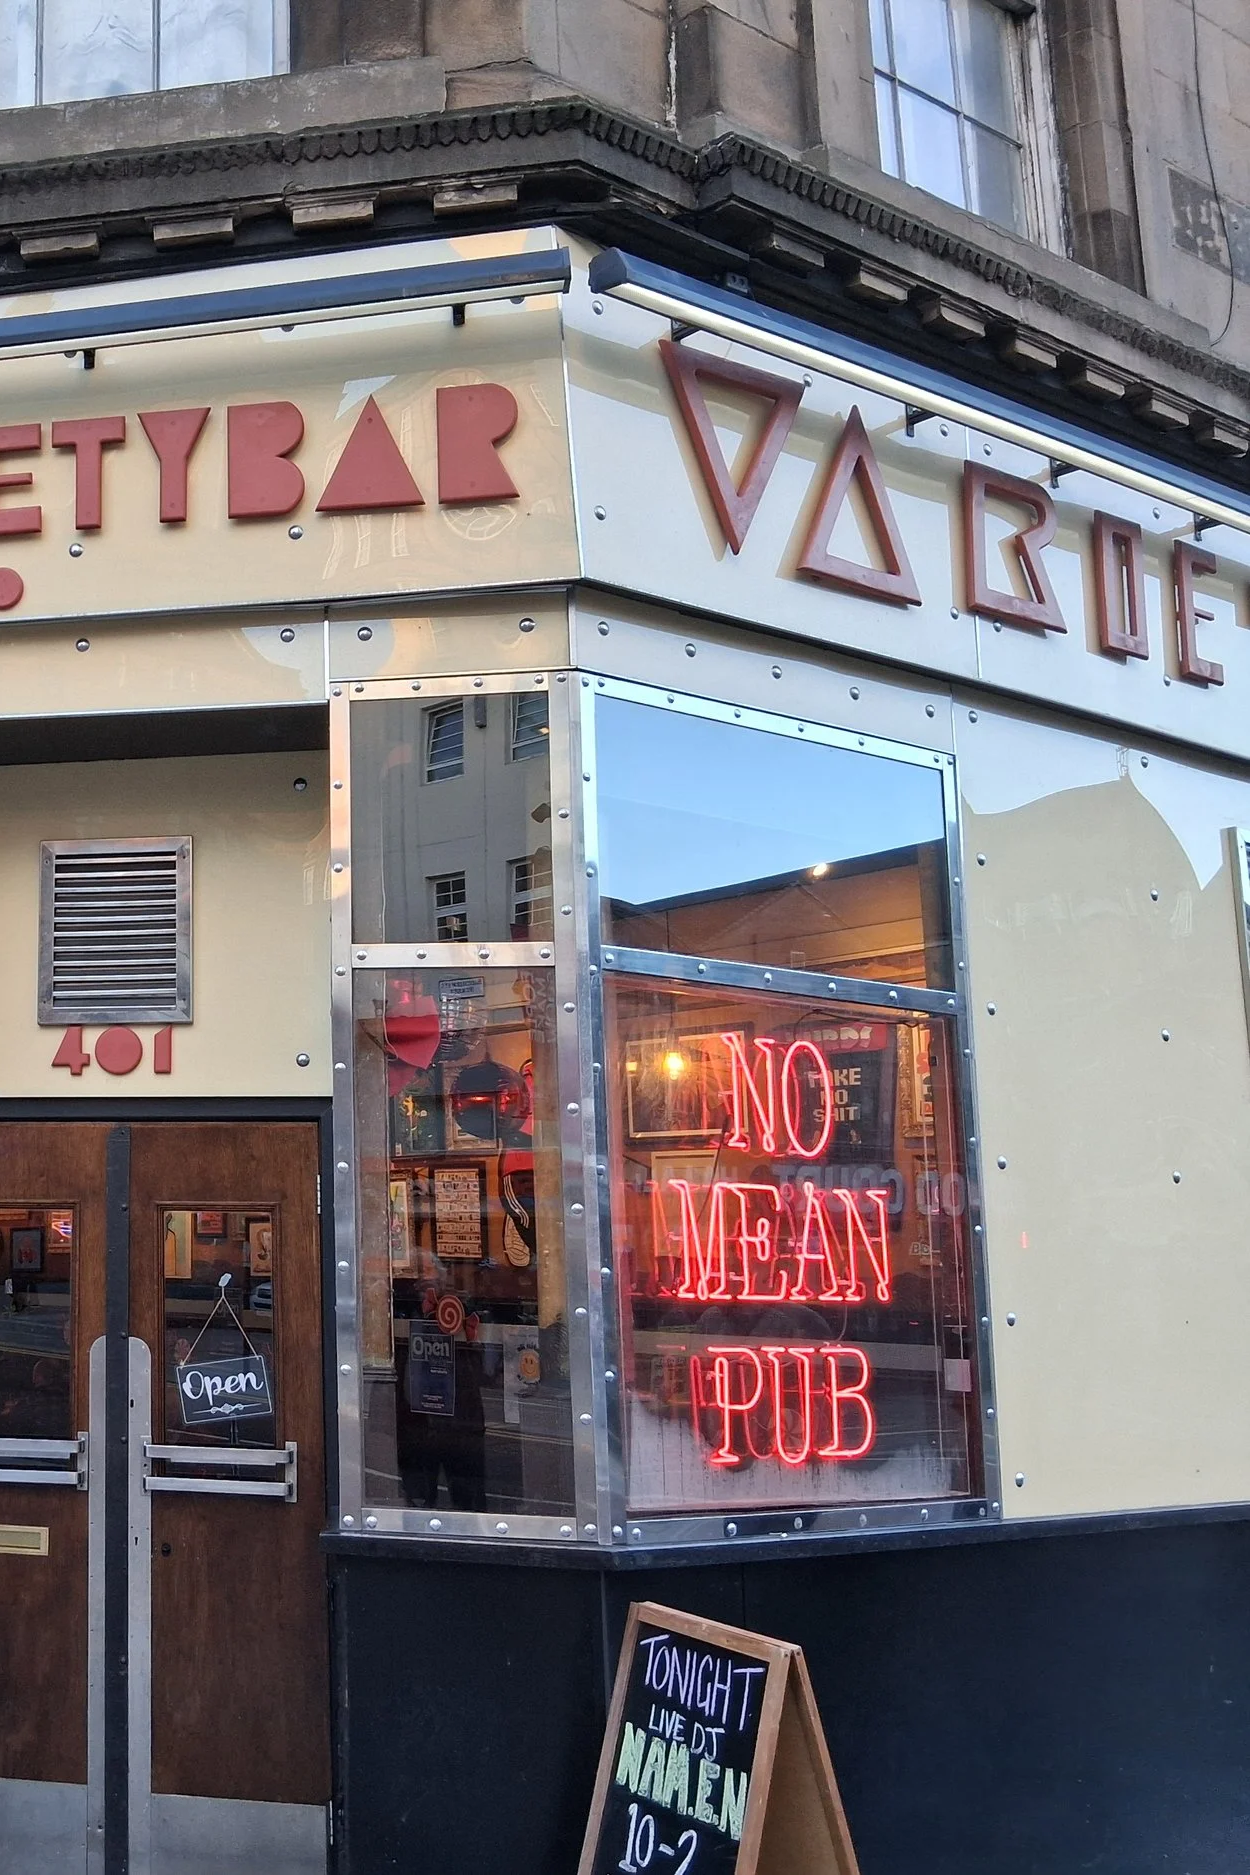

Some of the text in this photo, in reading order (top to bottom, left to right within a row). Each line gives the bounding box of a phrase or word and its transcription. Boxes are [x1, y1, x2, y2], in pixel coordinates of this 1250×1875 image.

[659, 339, 1250, 687] VARIE
[51, 1024, 173, 1076] 401
[720, 1032, 831, 1158] NO
[667, 1178, 890, 1302] MEAN
[181, 1370, 264, 1406] Open
[412, 1336, 451, 1361] Open
[707, 1345, 875, 1464] PUB
[640, 1634, 766, 1731] TONIGHT
[648, 1703, 726, 1762] LIVE DJ
[618, 1803, 698, 1875] 10-2
